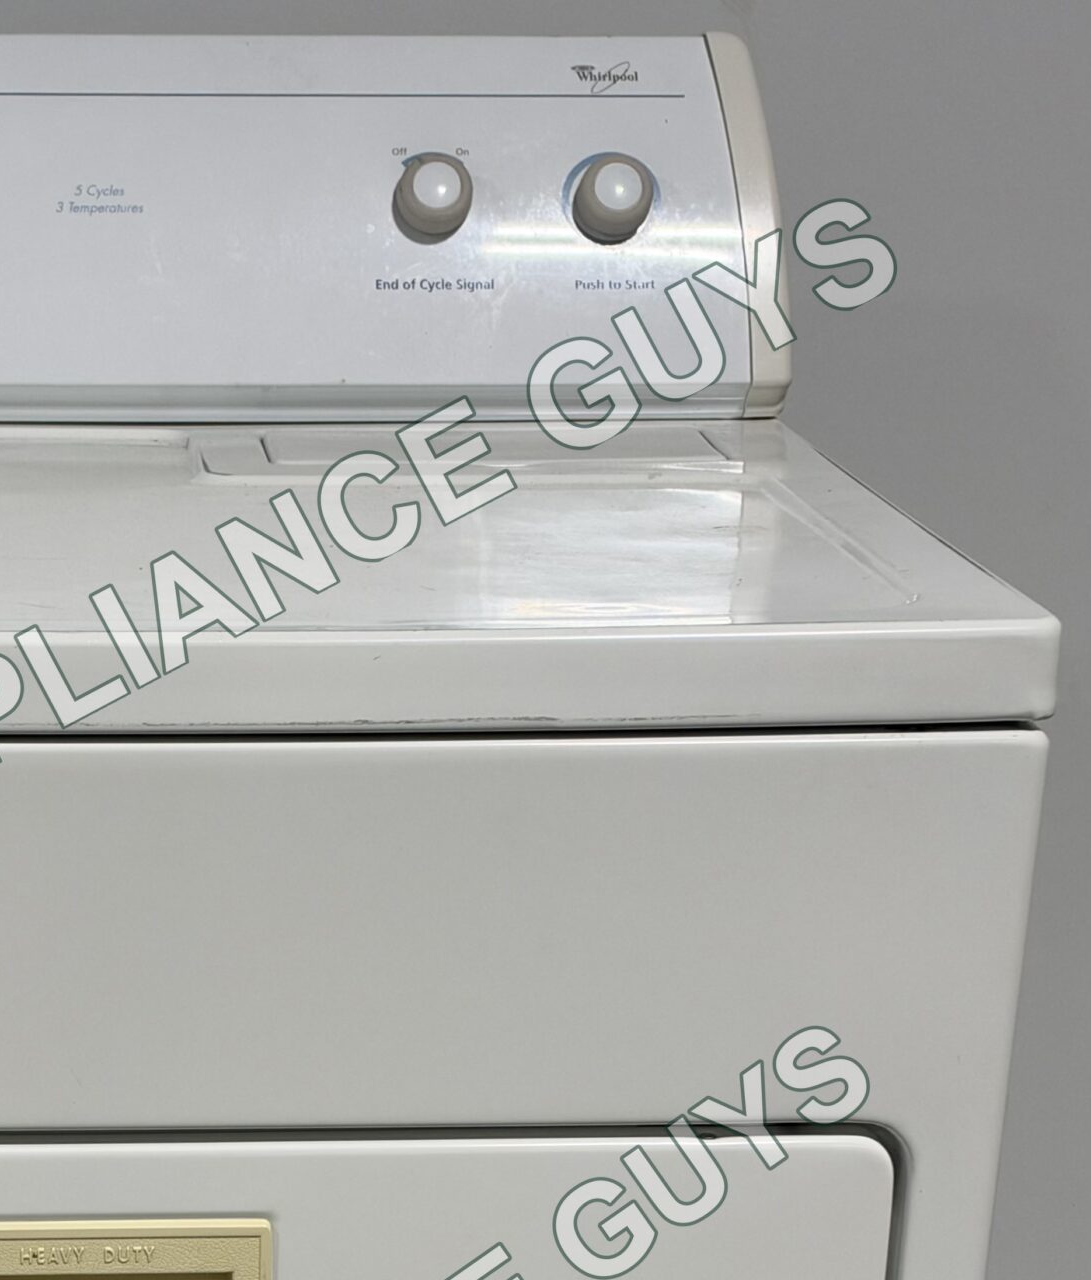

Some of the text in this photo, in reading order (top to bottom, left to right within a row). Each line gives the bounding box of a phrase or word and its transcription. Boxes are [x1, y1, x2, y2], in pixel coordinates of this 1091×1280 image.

[573, 66, 638, 86] Whirlpool
[391, 147, 407, 156] Off
[456, 147, 469, 156] On
[74, 183, 125, 200] 5 Cycles
[55, 201, 143, 216] 3 Temperatures
[375, 279, 495, 293] End of Cycle Signal
[575, 279, 655, 290] Push to Start
[19, 1245, 156, 1266] HEAVY DUTY
